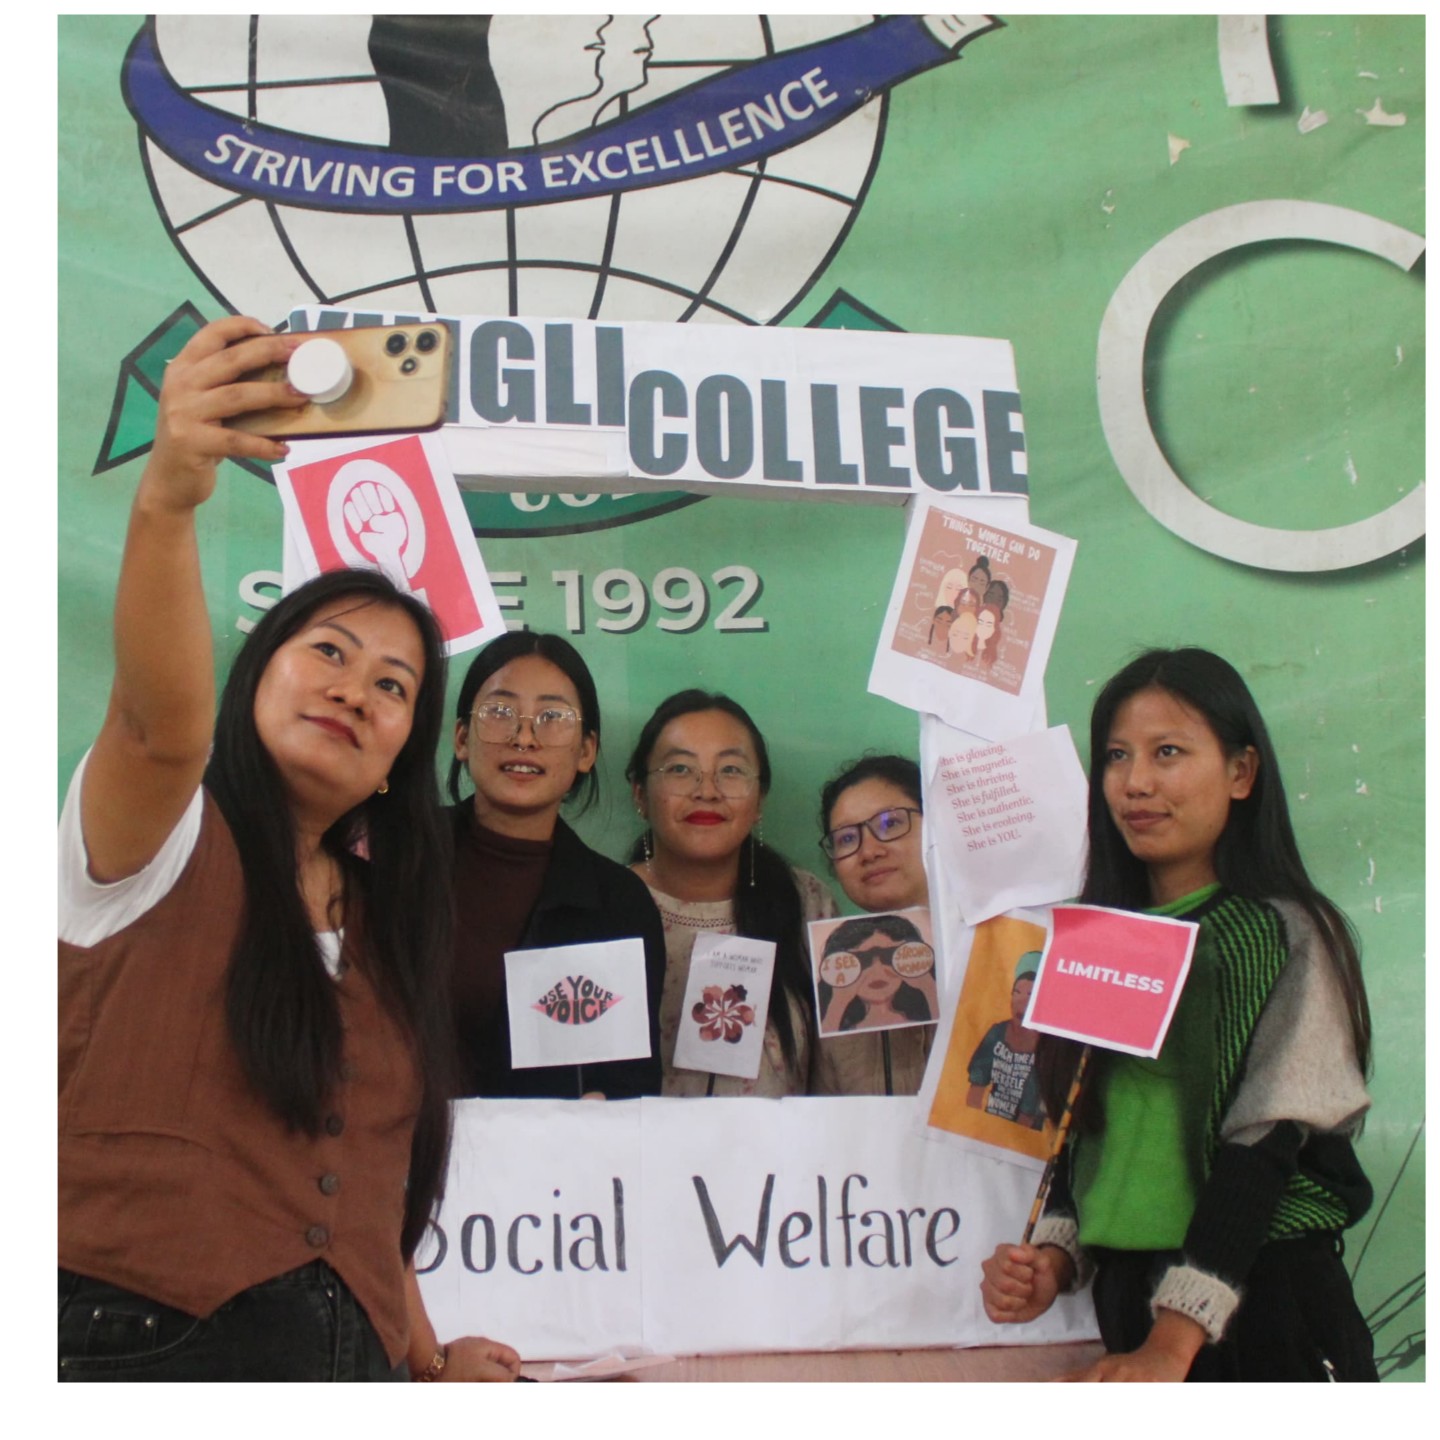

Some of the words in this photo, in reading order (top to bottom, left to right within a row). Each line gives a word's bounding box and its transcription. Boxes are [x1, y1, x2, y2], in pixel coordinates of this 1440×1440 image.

[205, 132, 416, 197] STRIVING
[432, 161, 526, 197] FOR
[541, 65, 839, 191] EXCELLLENCE
[628, 369, 1029, 496] COLLEGE
[943, 515, 974, 536] THINGS
[978, 528, 1007, 549] WOMEN
[1008, 539, 1026, 556] CAN
[1027, 546, 1041, 561] DO
[965, 537, 1011, 565] TOGETHER
[550, 565, 767, 634] 1992
[941, 770, 960, 782] She
[962, 766, 971, 777] is
[971, 756, 1017, 775] magnetic.
[957, 752, 965, 763] is
[946, 784, 965, 796] She
[967, 780, 976, 791] is
[976, 771, 1017, 788] thriving.
[951, 797, 971, 810] She
[972, 794, 981, 804] is
[981, 783, 1020, 804] fulfilled.
[956, 811, 976, 823] She
[977, 808, 986, 818] is
[987, 796, 1034, 816] authentic.
[961, 825, 981, 838] She
[982, 822, 992, 832] is
[992, 810, 1036, 830] evolving.
[967, 840, 987, 852] She
[988, 836, 997, 846] is
[997, 829, 1022, 844] YOU.
[834, 956, 859, 970] SEE
[1056, 958, 1165, 995] LIMITLESS
[538, 982, 565, 1006] USE
[566, 975, 613, 1002] YOUR
[545, 998, 609, 1026] VOICE
[692, 1173, 962, 1270] Welfare
